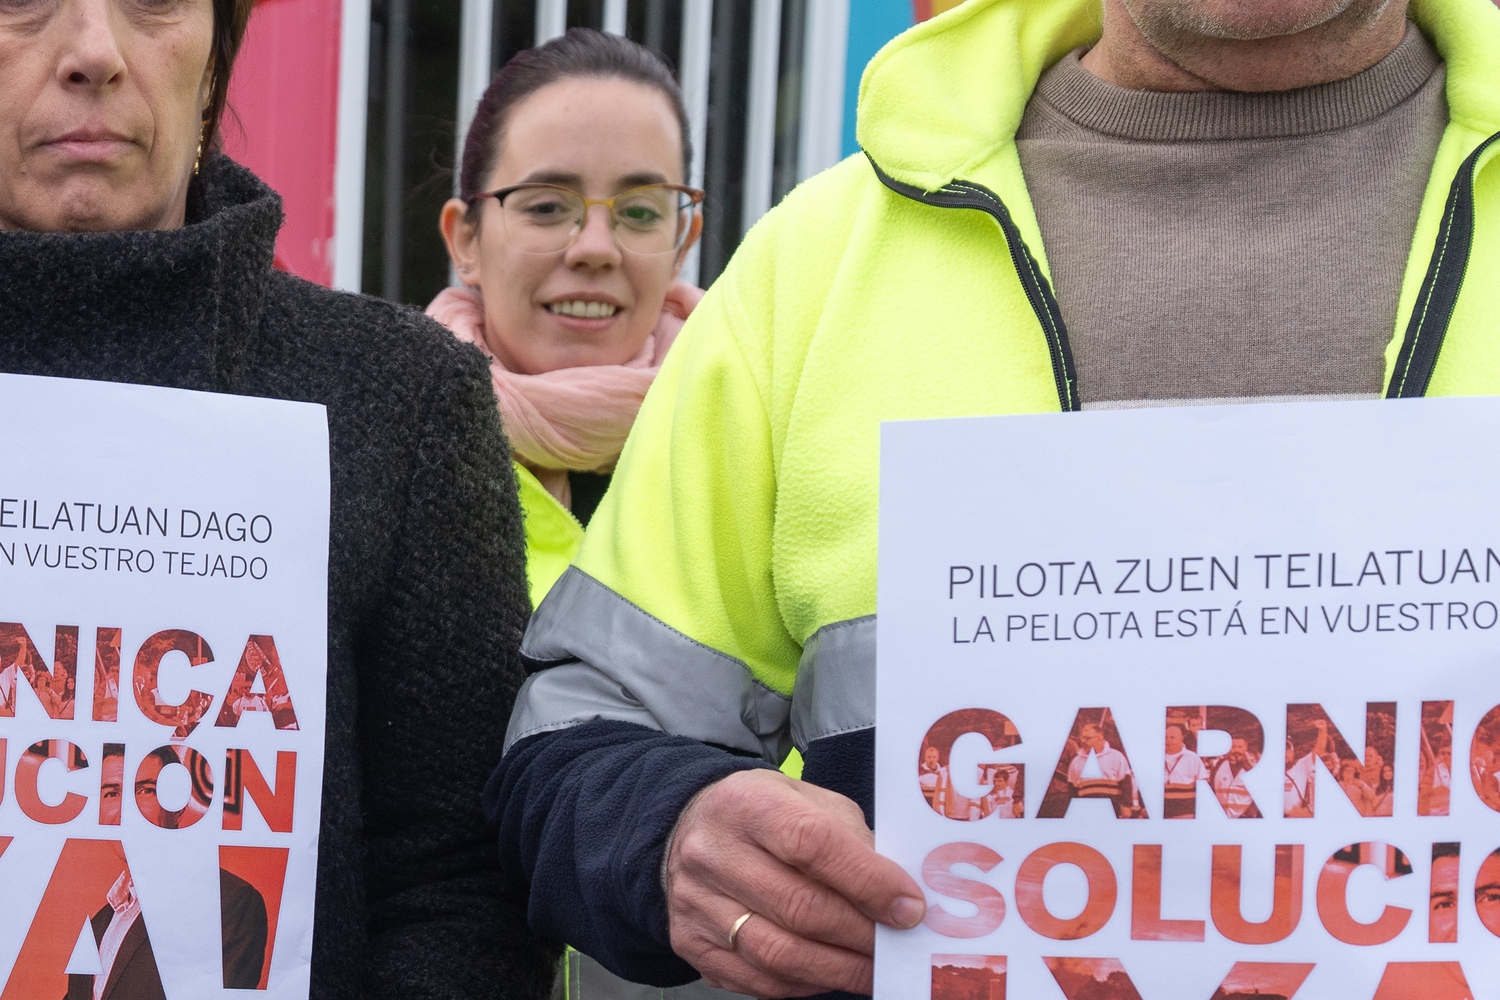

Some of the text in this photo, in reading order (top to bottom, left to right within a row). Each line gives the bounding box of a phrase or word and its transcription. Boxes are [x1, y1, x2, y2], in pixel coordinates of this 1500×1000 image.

[180, 509, 273, 544] DAGO
[24, 544, 155, 573] VUESTRO
[163, 551, 268, 580] TEJADO
[949, 561, 1103, 600] PILOTA
[1114, 555, 1240, 595] ZUEN
[952, 600, 1498, 643] LA PELOTA ESTÁ EN VUESTRO
[921, 841, 1500, 946] SOLUCI
